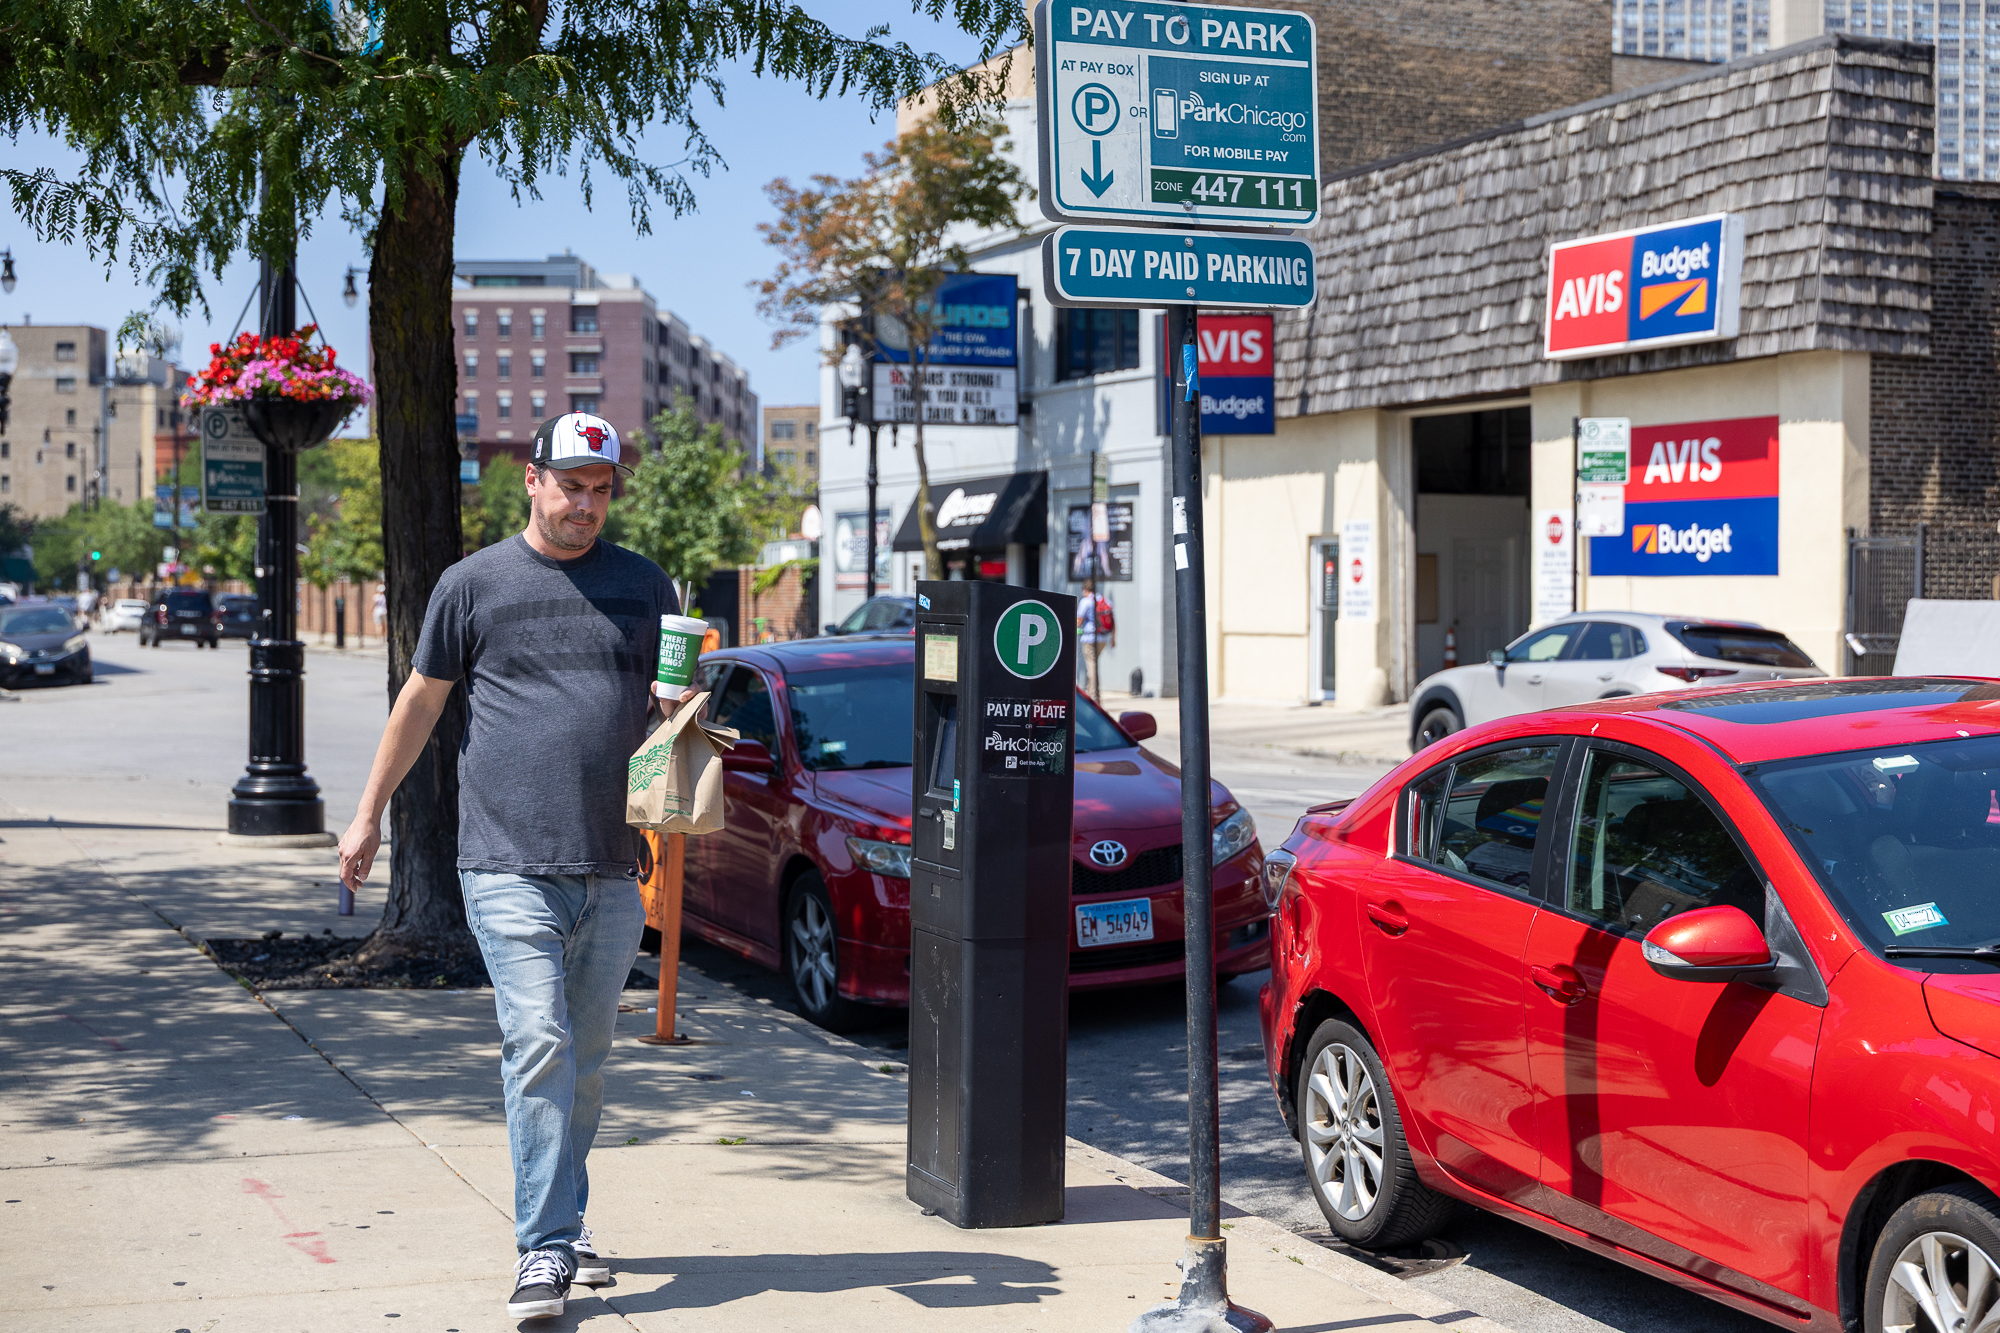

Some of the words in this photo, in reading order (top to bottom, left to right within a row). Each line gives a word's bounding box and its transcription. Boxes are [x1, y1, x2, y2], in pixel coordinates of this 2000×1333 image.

[1070, 7, 1134, 40] PAY
[1143, 13, 1190, 46] TO
[1201, 19, 1294, 54] PARK
[1060, 60, 1077, 71] AT
[1080, 61, 1104, 74] PAY
[1107, 63, 1134, 77] BOX
[1199, 71, 1230, 85] SIGN
[1233, 74, 1252, 86] UP
[1253, 75, 1270, 87] AT
[1129, 106, 1148, 118] OR
[1180, 99, 1306, 132] ParkChicago
[1280, 132, 1306, 143] .com
[1184, 145, 1210, 158] FOR
[1213, 147, 1263, 161] MOBILE
[1265, 150, 1289, 162] PAY
[1154, 181, 1183, 192] ZONE
[1191, 175, 1244, 203] 447
[1254, 179, 1303, 206] 111
[1066, 248, 1081, 276] 7
[1090, 248, 1136, 278] DAY
[1144, 250, 1198, 280] PAID
[1207, 253, 1307, 286] PARKING
[1641, 241, 1711, 280] Budget
[1554, 269, 1624, 321] AVIS
[1198, 329, 1263, 363] VIS
[1200, 394, 1265, 420] Budget
[1643, 437, 1722, 484] AVIS
[1658, 523, 1732, 563] Budget
[662, 633, 687, 645] WHERE
[661, 656, 682, 668] WINGS
[674, 651, 686, 660] ITS
[987, 703, 1010, 717] PAY
[1013, 703, 1031, 717] BY
[1033, 704, 1066, 719] PLATE
[985, 737, 1063, 755] ParkChicago
[1096, 902, 1132, 912] ILLINOIS
[1081, 916, 1098, 938] EM
[1106, 911, 1148, 934] 54949
